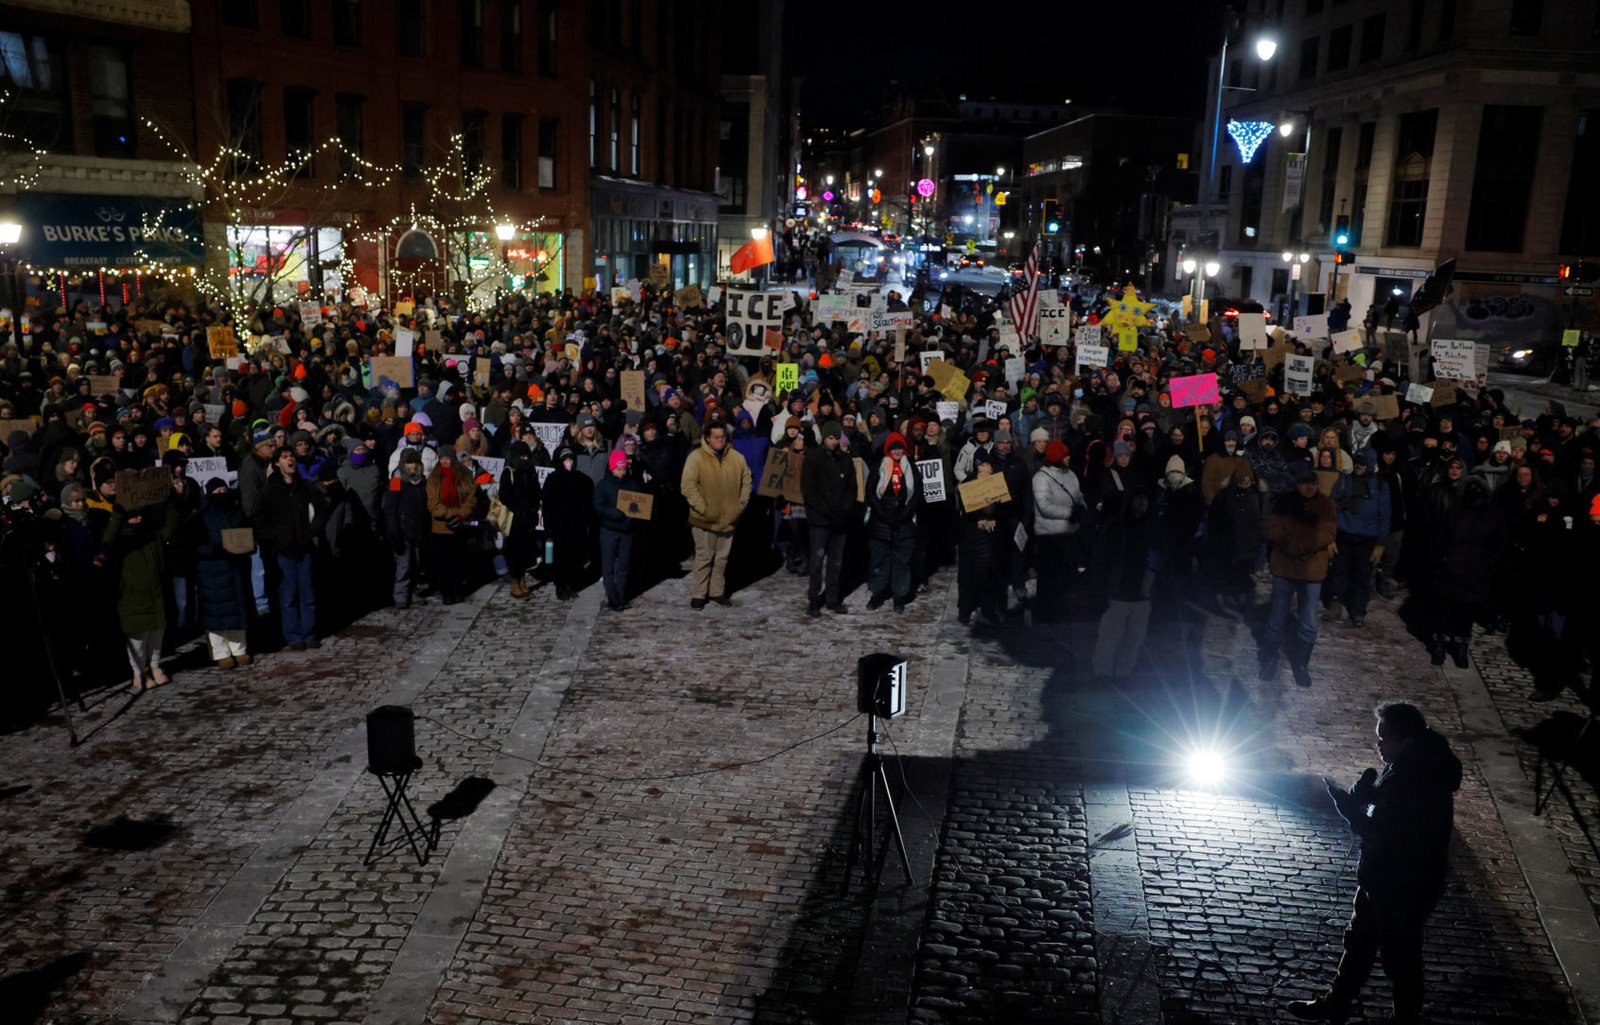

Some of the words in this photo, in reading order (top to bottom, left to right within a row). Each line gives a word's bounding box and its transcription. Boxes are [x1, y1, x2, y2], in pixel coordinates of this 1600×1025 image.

[43, 225, 125, 242] BURKE'S
[65, 256, 108, 265] BREAKFAST
[729, 293, 784, 320] ICE
[1040, 309, 1065, 318] ICE
[727, 322, 782, 350] OU
[1434, 341, 1447, 349] From
[782, 367, 793, 380] ICE
[1230, 364, 1247, 376] ARE
[1250, 365, 1264, 377] WE
[779, 381, 795, 390] OUT
[917, 461, 940, 479] TOP
[923, 481, 942, 490] ERROR
[923, 489, 942, 497] OW!
